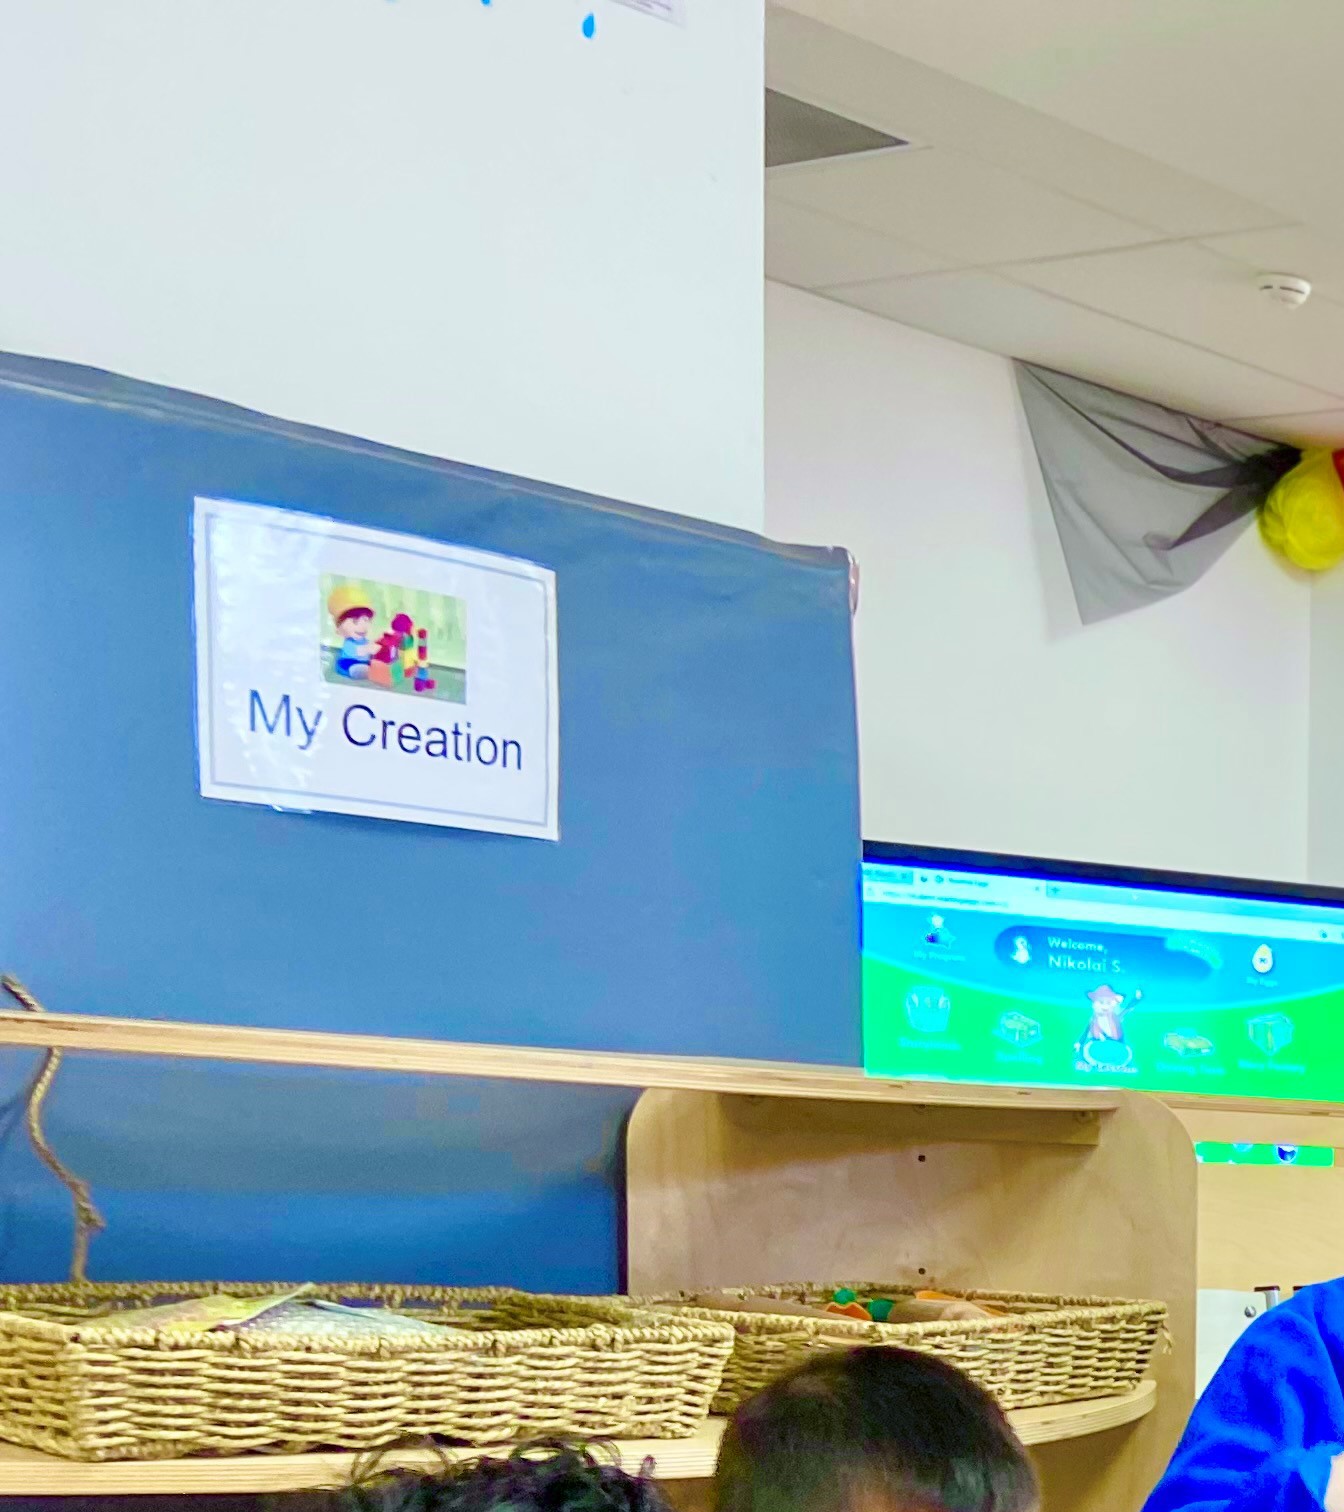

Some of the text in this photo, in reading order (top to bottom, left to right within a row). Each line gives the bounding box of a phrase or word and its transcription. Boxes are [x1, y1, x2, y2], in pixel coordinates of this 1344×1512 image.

[249, 689, 522, 770] My Creation
[1047, 936, 1107, 954] Welcome,
[1048, 955, 1106, 972] Nikolai
